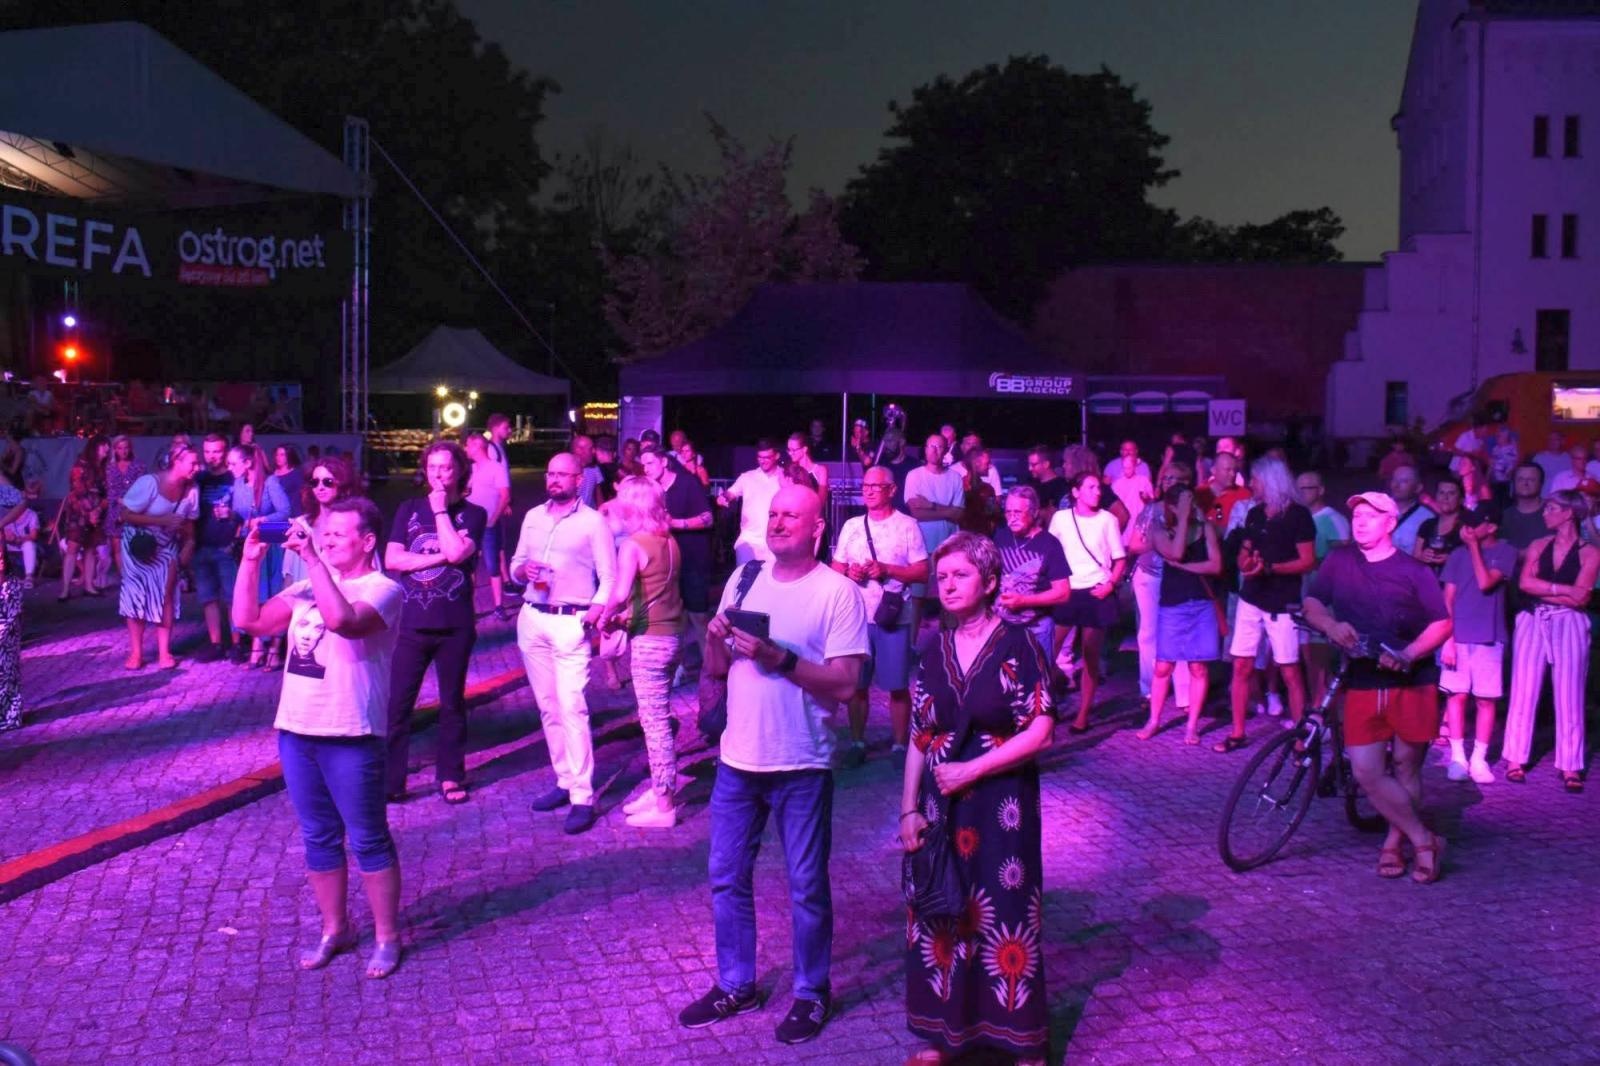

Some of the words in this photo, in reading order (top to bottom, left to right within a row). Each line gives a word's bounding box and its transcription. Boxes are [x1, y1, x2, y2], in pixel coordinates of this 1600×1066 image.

[1025, 379, 1072, 388] GROUP
[1025, 386, 1072, 395] AGENCY
[1211, 409, 1242, 426] WC
